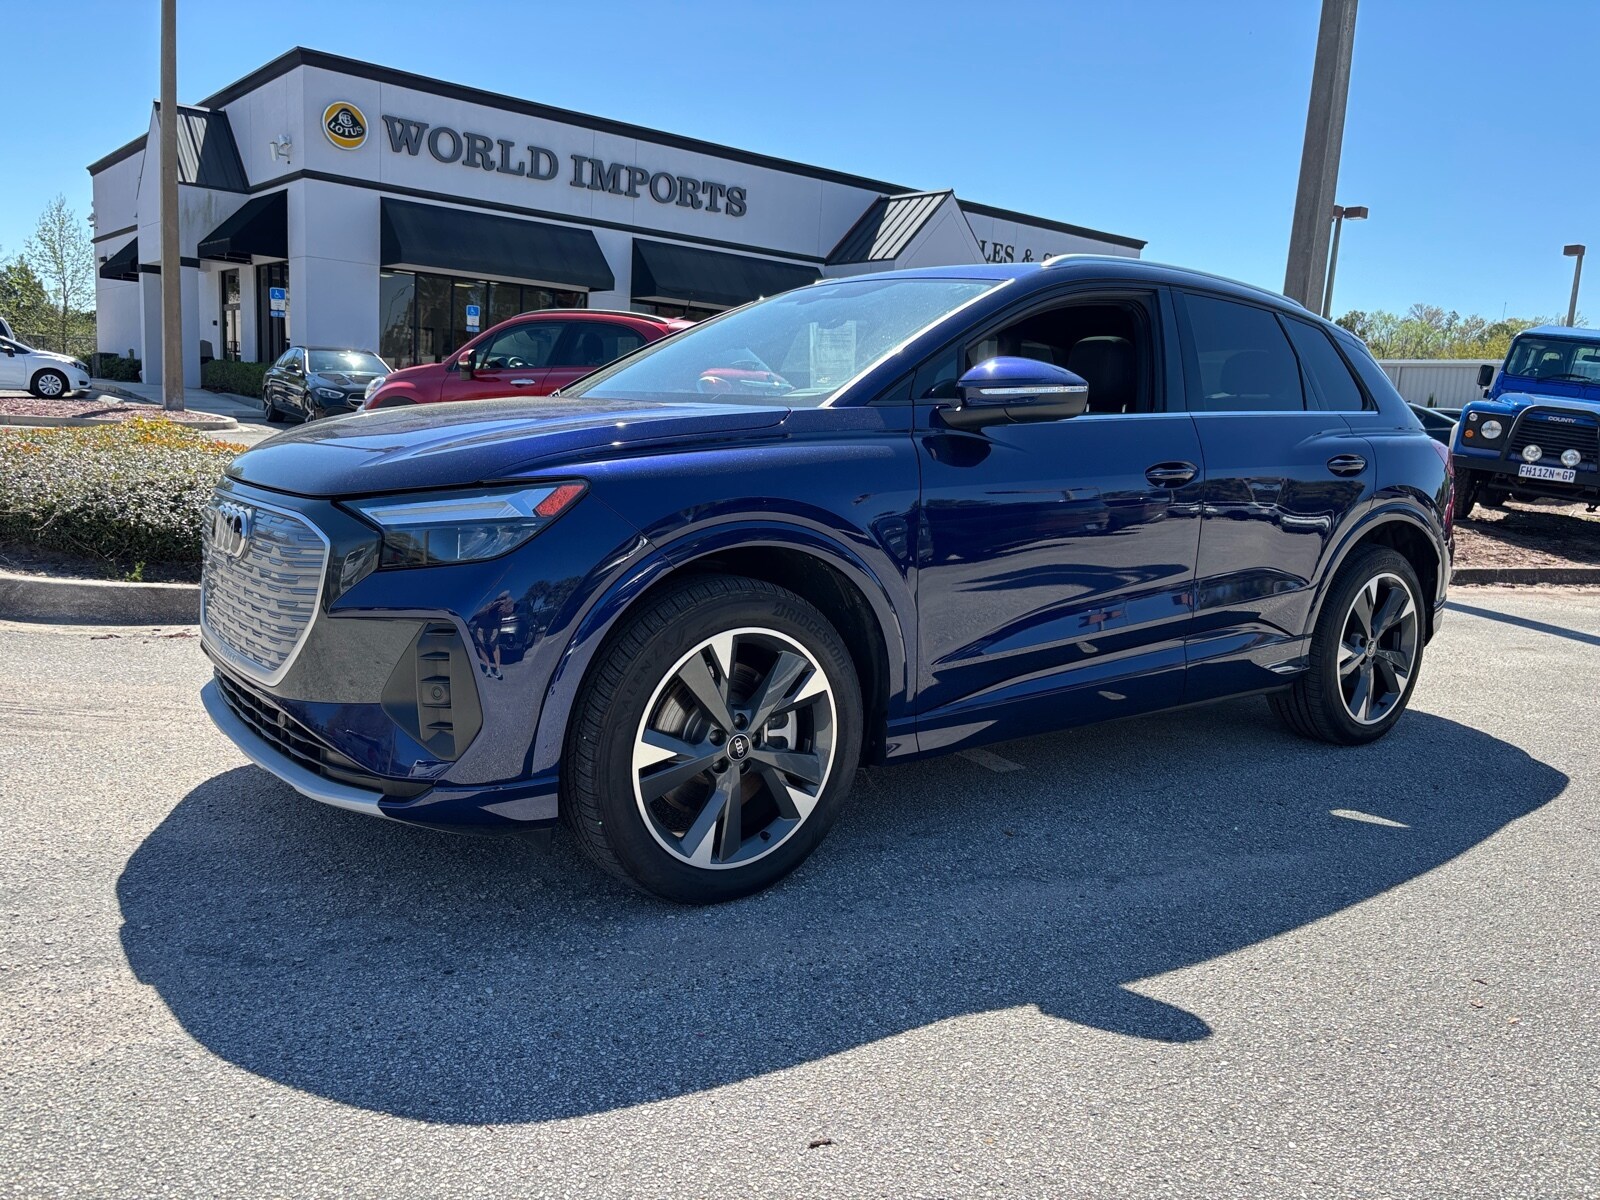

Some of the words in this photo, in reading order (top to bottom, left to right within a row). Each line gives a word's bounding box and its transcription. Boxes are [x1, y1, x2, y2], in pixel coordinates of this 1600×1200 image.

[329, 121, 363, 136] LOTUS
[382, 114, 559, 181] WORLD
[569, 154, 748, 218] IMPORTS
[1022, 248, 1035, 263] &
[1547, 415, 1577, 424] COUNTY
[1519, 465, 1556, 479] FH11ZN
[1561, 470, 1575, 481] GP
[772, 601, 850, 675] BRIDGESTONE
